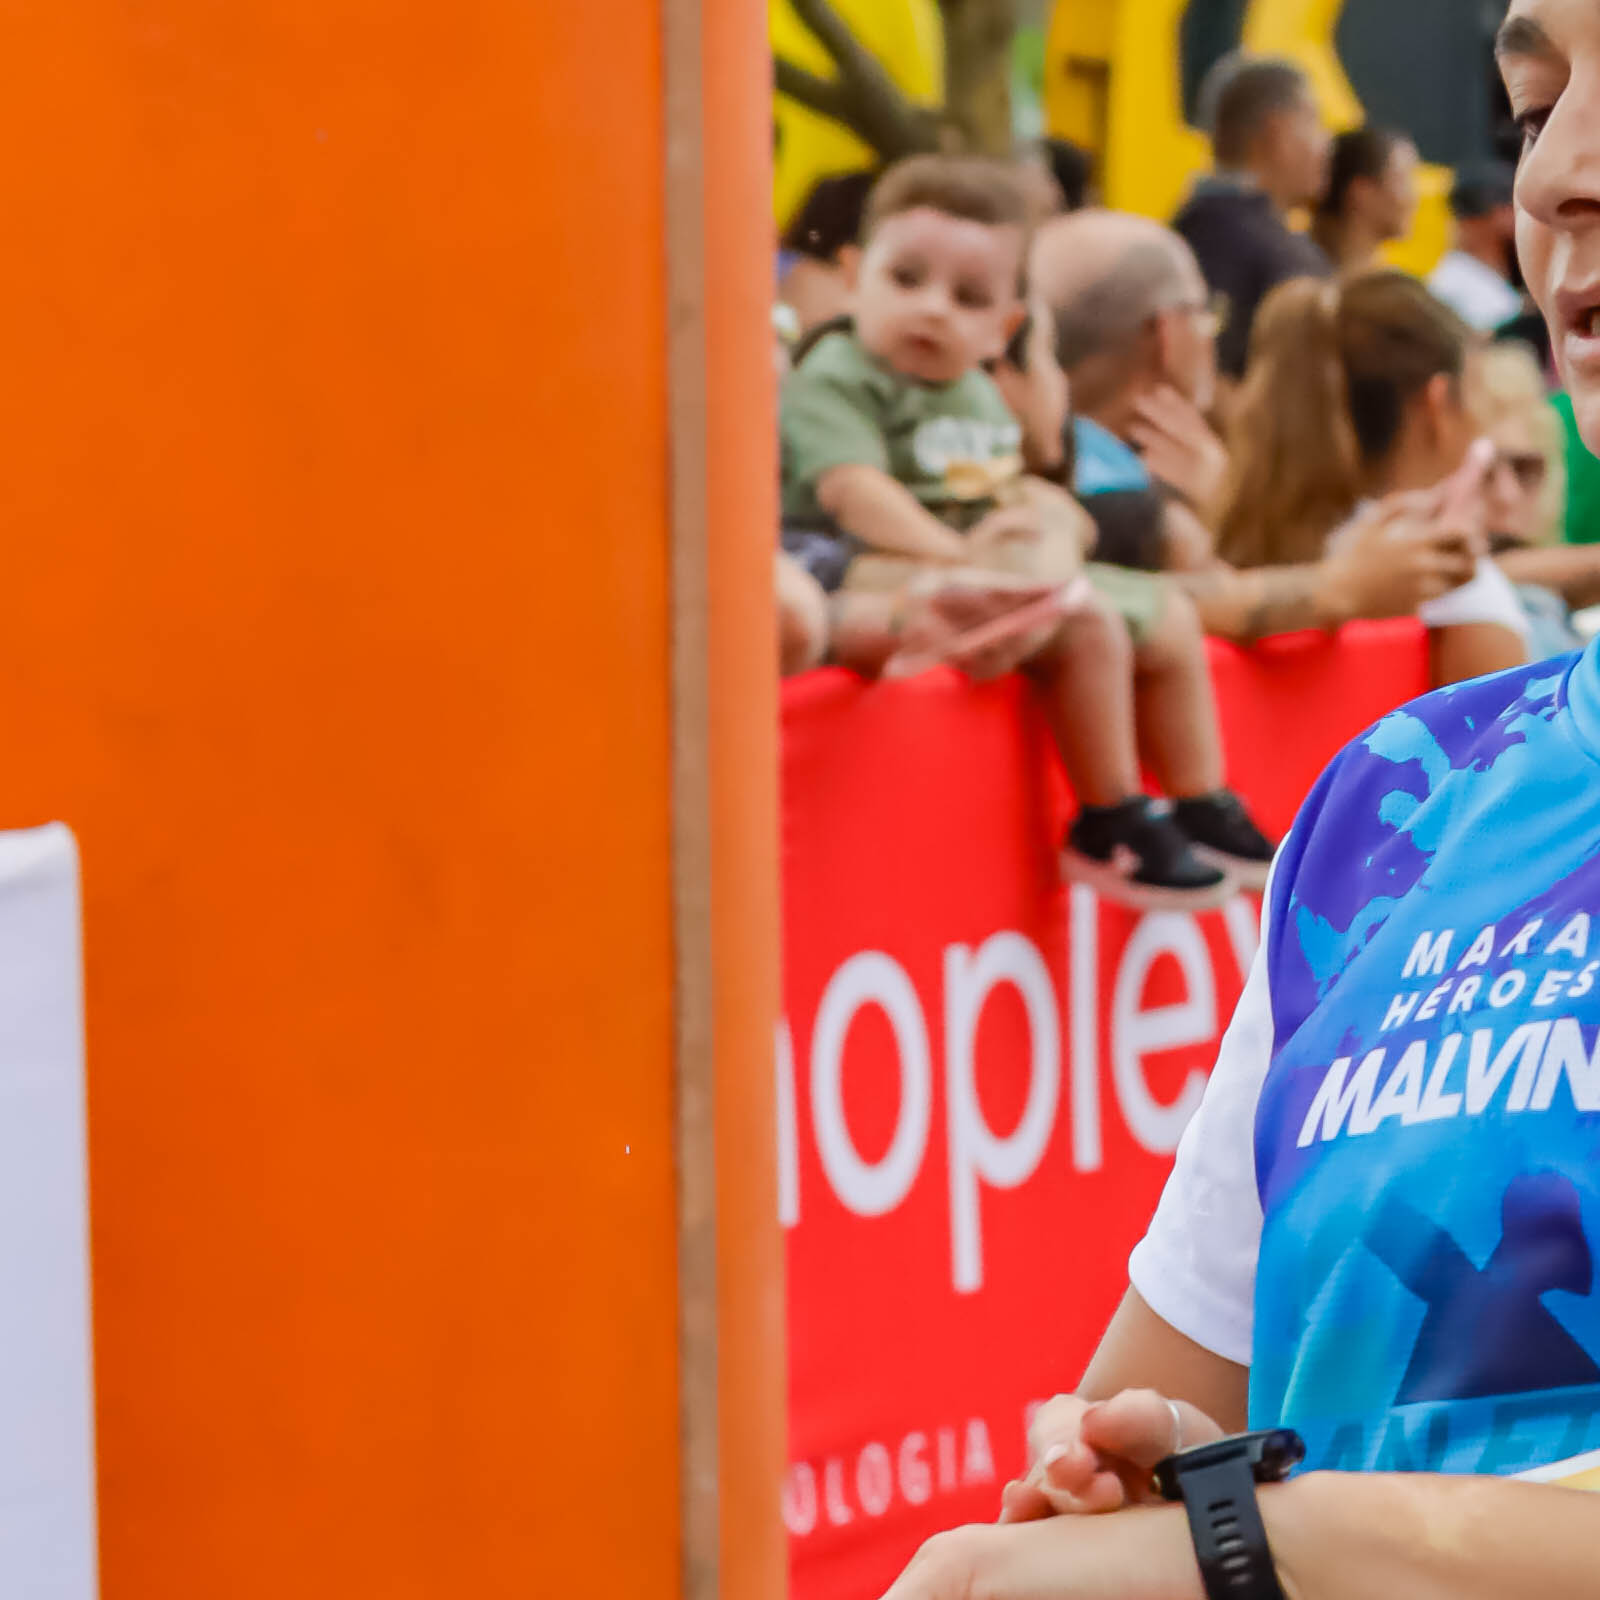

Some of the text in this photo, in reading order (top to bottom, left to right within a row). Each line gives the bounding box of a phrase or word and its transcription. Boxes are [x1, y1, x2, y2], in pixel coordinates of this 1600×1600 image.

[1379, 960, 1600, 1032] HÉROES
[776, 884, 1260, 1295] ople
[781, 1415, 995, 1537] OLOGIA
